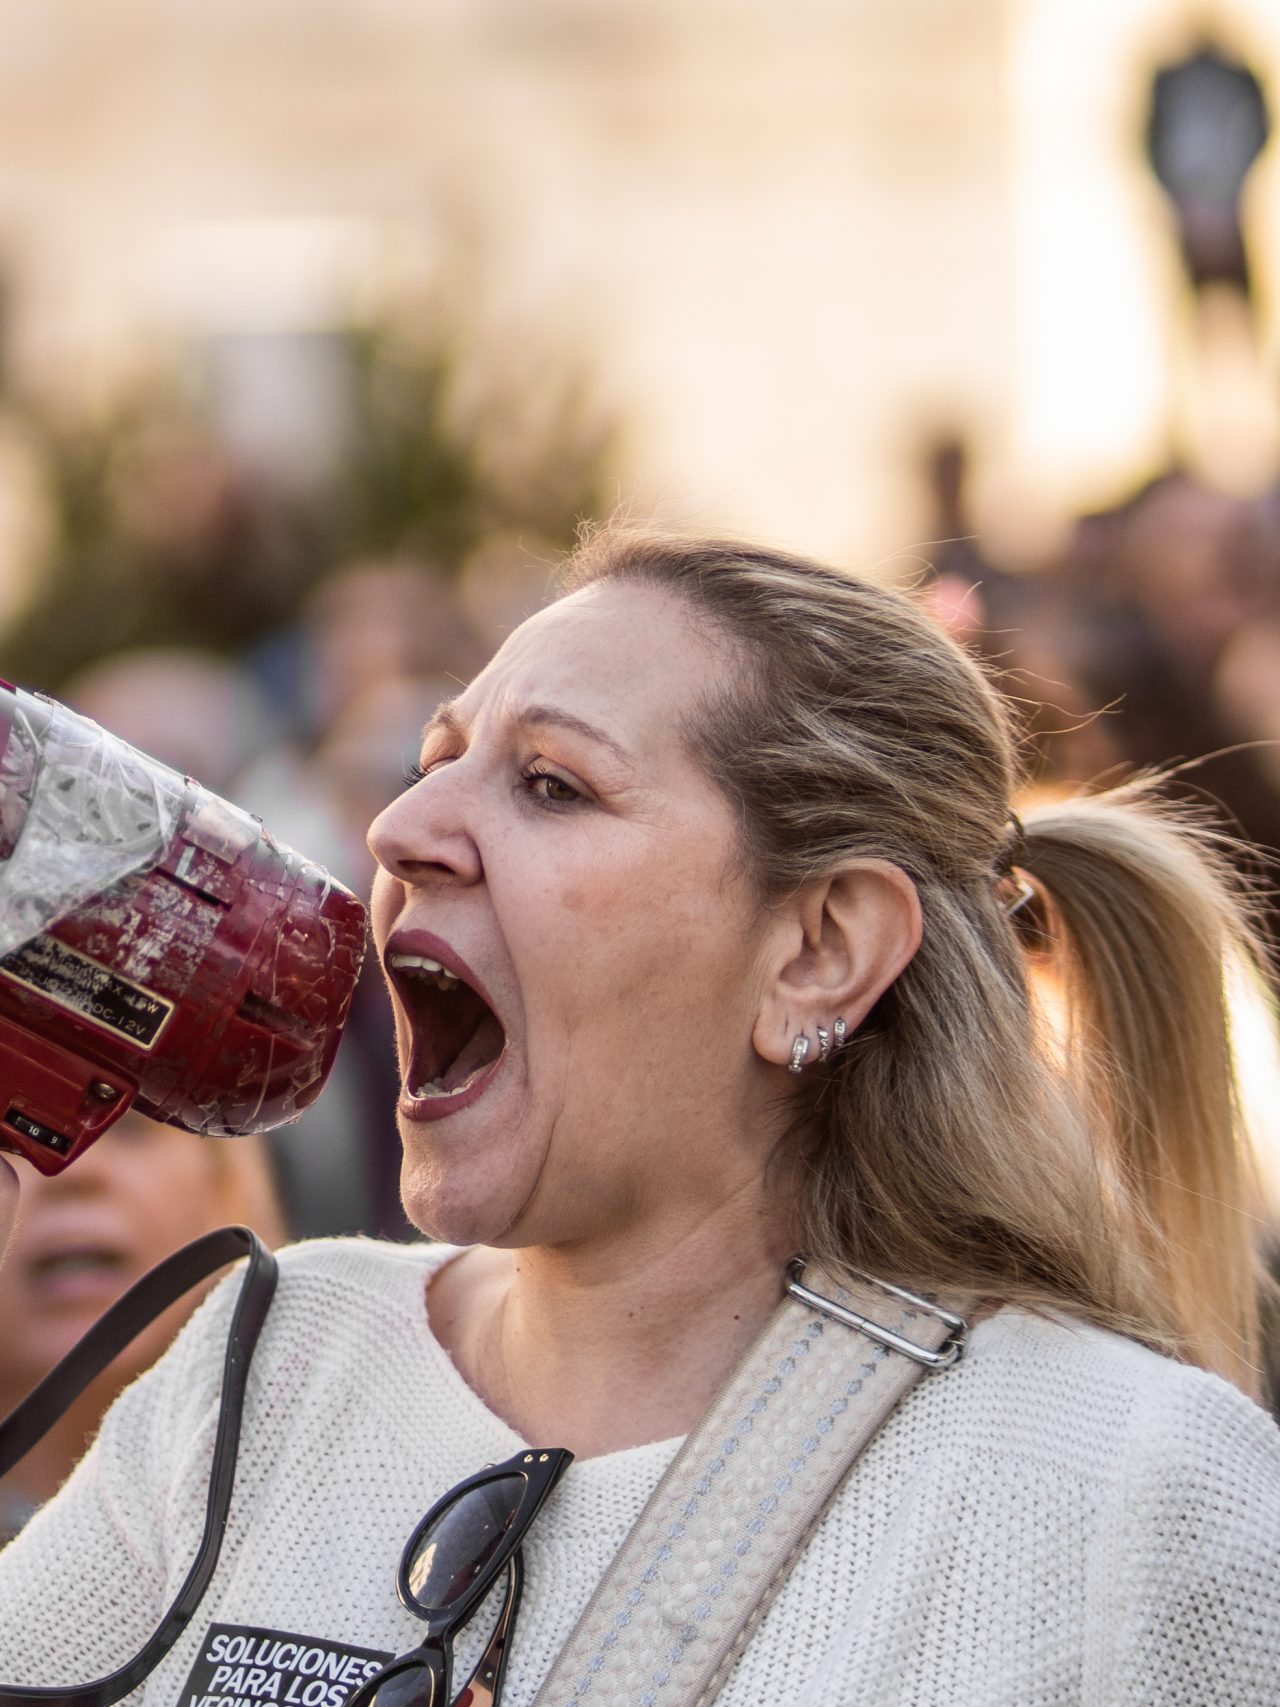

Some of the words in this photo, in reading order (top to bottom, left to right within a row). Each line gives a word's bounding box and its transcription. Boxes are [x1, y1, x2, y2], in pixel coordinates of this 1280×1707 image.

[92, 1002, 147, 1036] DC-12V
[28, 1125, 40, 1137] 10
[50, 1135, 58, 1145] 9
[206, 1635, 384, 1687] SOLUCIONES
[207, 1666, 282, 1699] PARA
[284, 1676, 348, 1707] LOS
